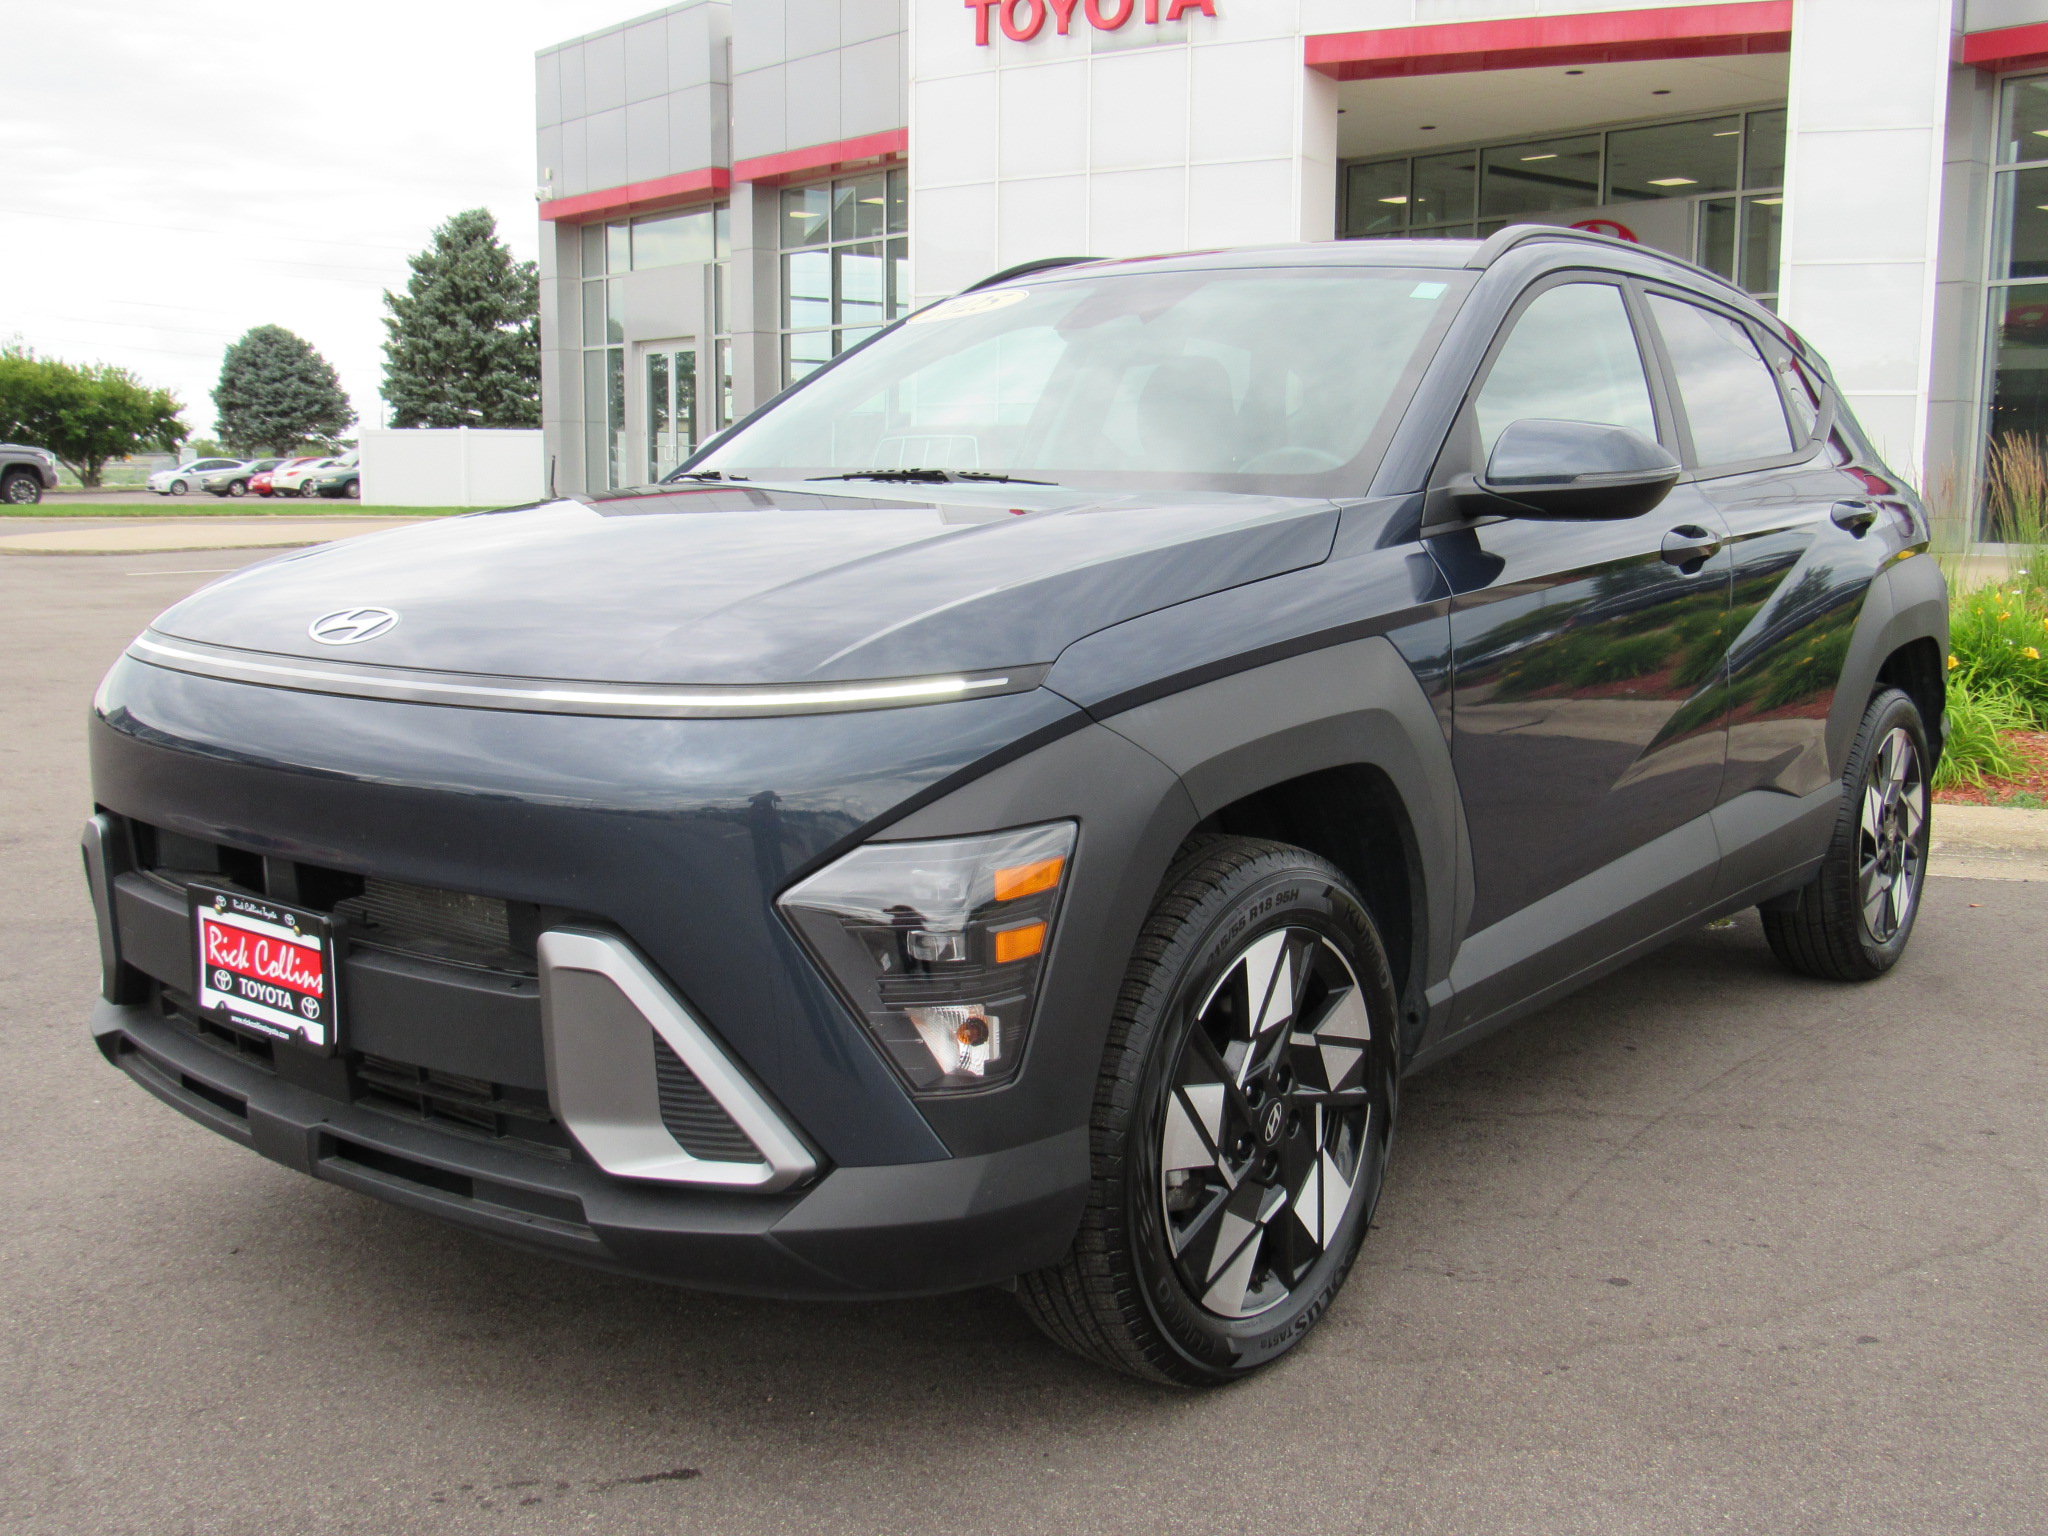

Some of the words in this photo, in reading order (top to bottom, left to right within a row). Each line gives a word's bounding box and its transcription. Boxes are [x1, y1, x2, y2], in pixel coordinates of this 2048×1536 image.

[1249, 896, 1273, 923] R18
[1275, 888, 1300, 908] 95H
[208, 925, 250, 970] Rick
[254, 939, 324, 994] Collins
[238, 977, 294, 1011] TOYOTA
